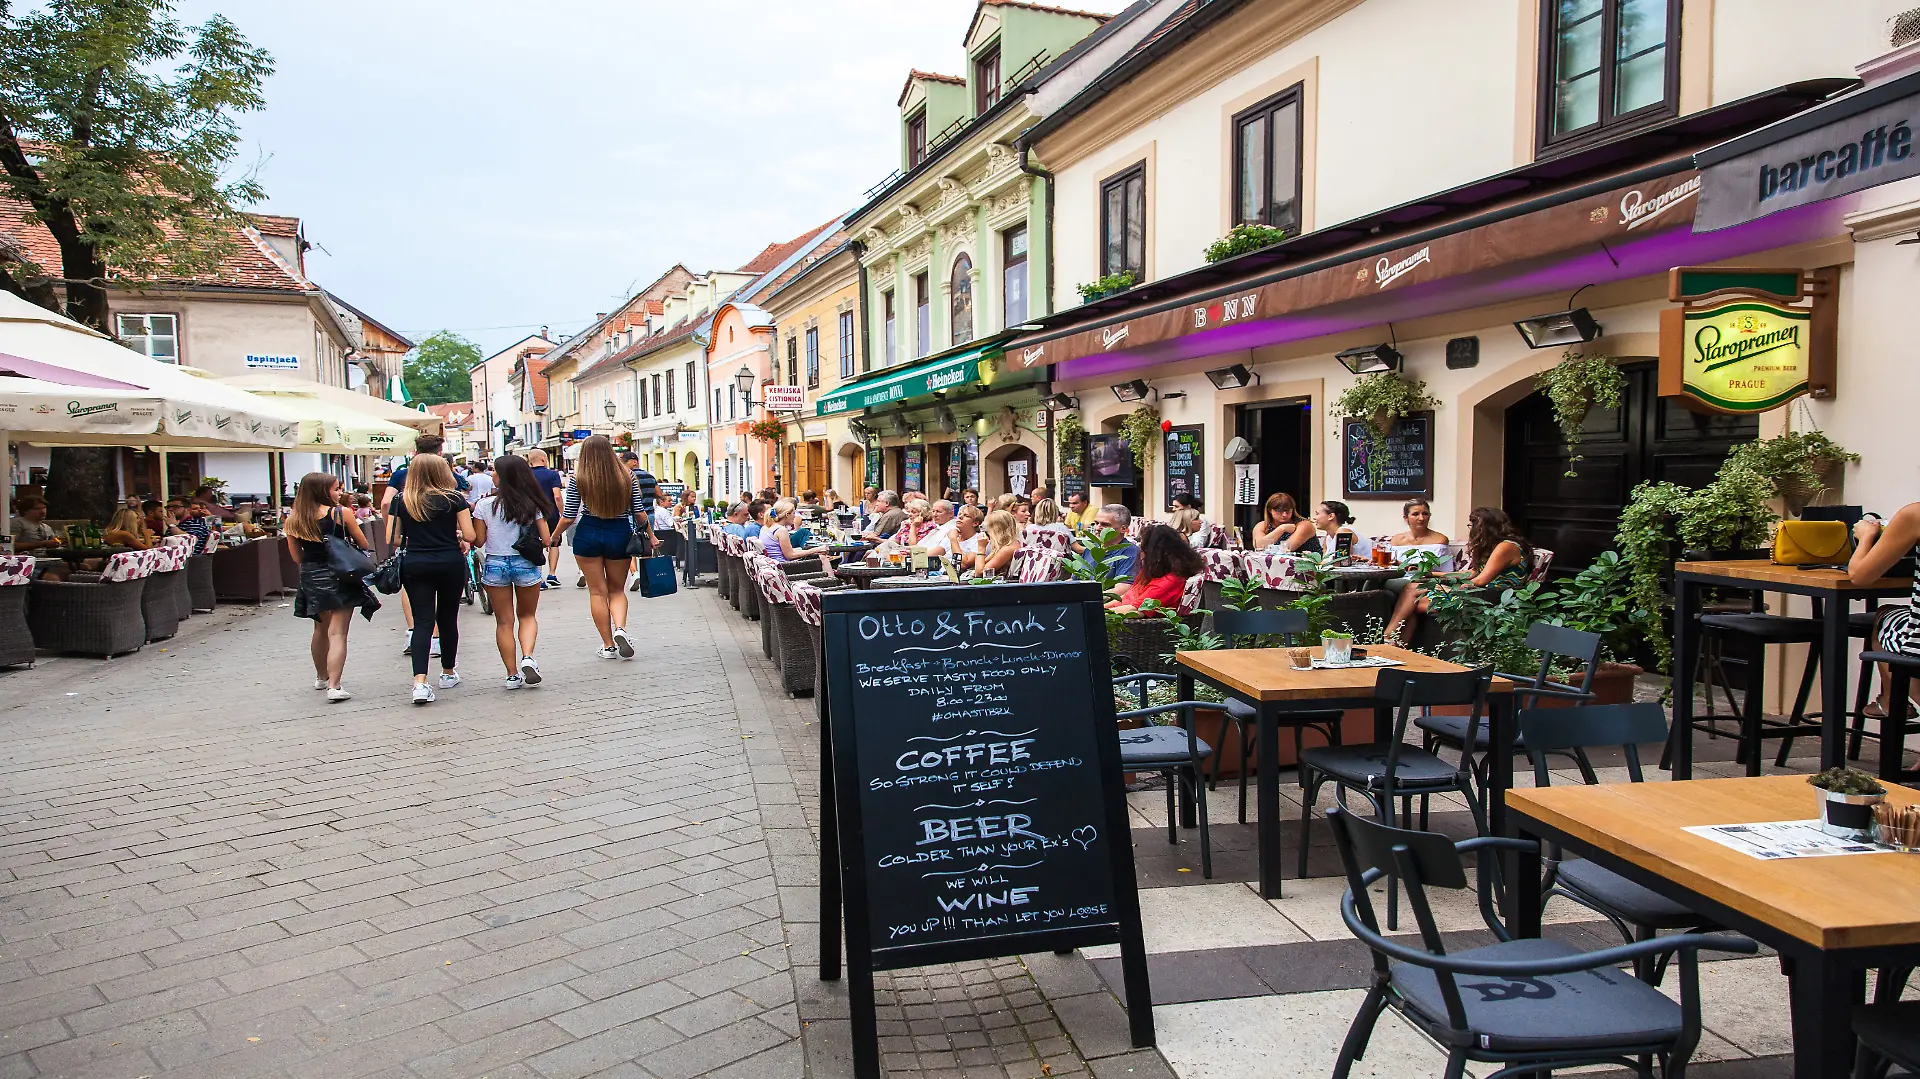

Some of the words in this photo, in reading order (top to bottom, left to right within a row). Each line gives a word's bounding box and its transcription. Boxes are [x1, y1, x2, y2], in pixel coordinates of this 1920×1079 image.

[1759, 120, 1912, 202] barcaffé
[1619, 175, 1700, 227] Staroprame
[1375, 245, 1431, 287] Staropramen
[1694, 325, 1800, 366] Staropramen
[932, 364, 964, 389] Heineken
[1728, 380, 1765, 388] PRAGUE
[66, 400, 118, 416] Staropramen
[827, 397, 847, 412] Heineken
[859, 614, 926, 640] Otto
[933, 611, 961, 640] &
[964, 611, 1045, 637] Frank
[856, 658, 930, 674] Breakfast
[942, 654, 993, 669] Brunch
[1001, 652, 1041, 664] Lunch
[1044, 650, 1082, 661] Dinner
[933, 672, 977, 683] TASTY
[981, 669, 1015, 680] FOOD
[1021, 666, 1057, 676] ONLY
[908, 686, 953, 697] DAILY
[962, 683, 1005, 694] FROM
[896, 738, 1036, 771] COFFEE
[895, 771, 959, 787] STRONG
[964, 770, 977, 779] IT
[981, 765, 1027, 778] COULD
[1029, 757, 1082, 770] DEFEND
[952, 784, 966, 793] IT
[916, 813, 1049, 846] BEER
[878, 849, 954, 868] COLDER
[957, 844, 995, 856] THAN
[1000, 840, 1037, 857] YOUR
[945, 878, 966, 889] WE
[971, 874, 1009, 886] WILL
[936, 886, 1040, 912] WINE
[889, 923, 917, 939] YOU
[962, 914, 1008, 929] THAN
[1016, 911, 1040, 922] LET
[1043, 909, 1065, 922] YOU
[1069, 904, 1108, 918] LOOSE
